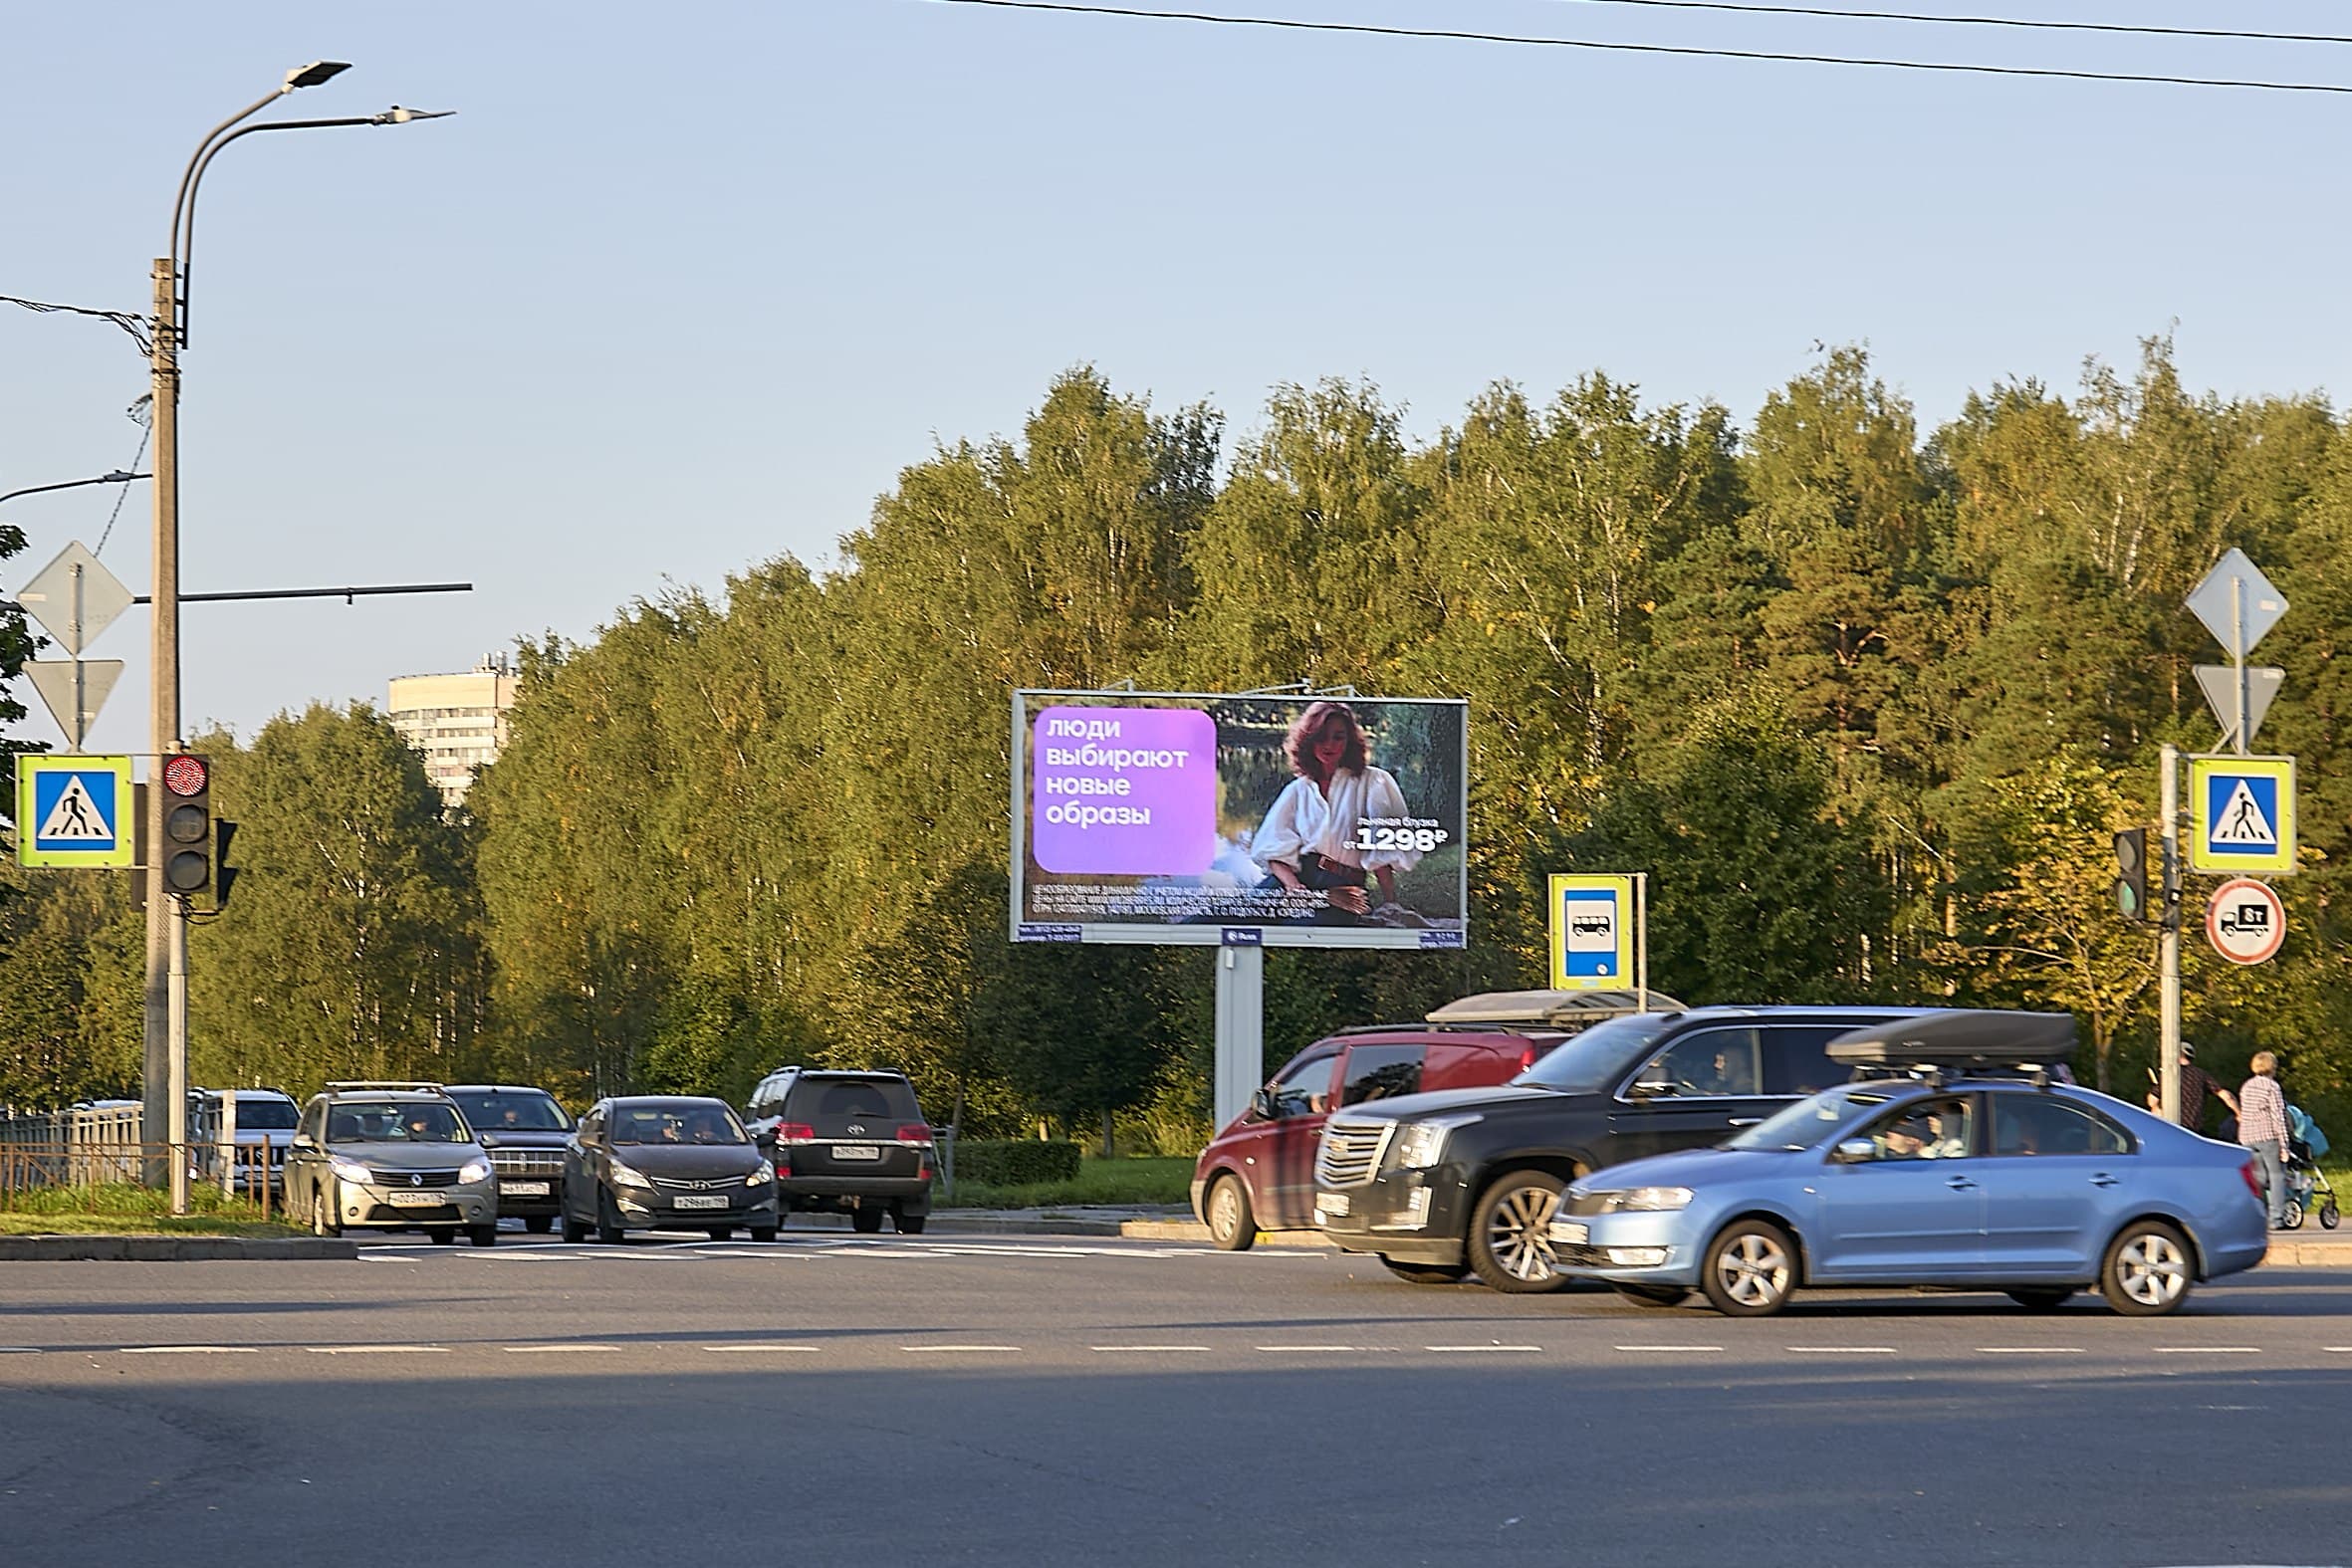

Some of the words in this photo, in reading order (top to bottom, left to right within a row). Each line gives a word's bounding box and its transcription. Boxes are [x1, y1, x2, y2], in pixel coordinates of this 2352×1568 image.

[1047, 719, 1121, 741] люди
[1046, 743, 1189, 773] выбирают
[1046, 777, 1131, 795] новые
[1046, 799, 1151, 829] образы
